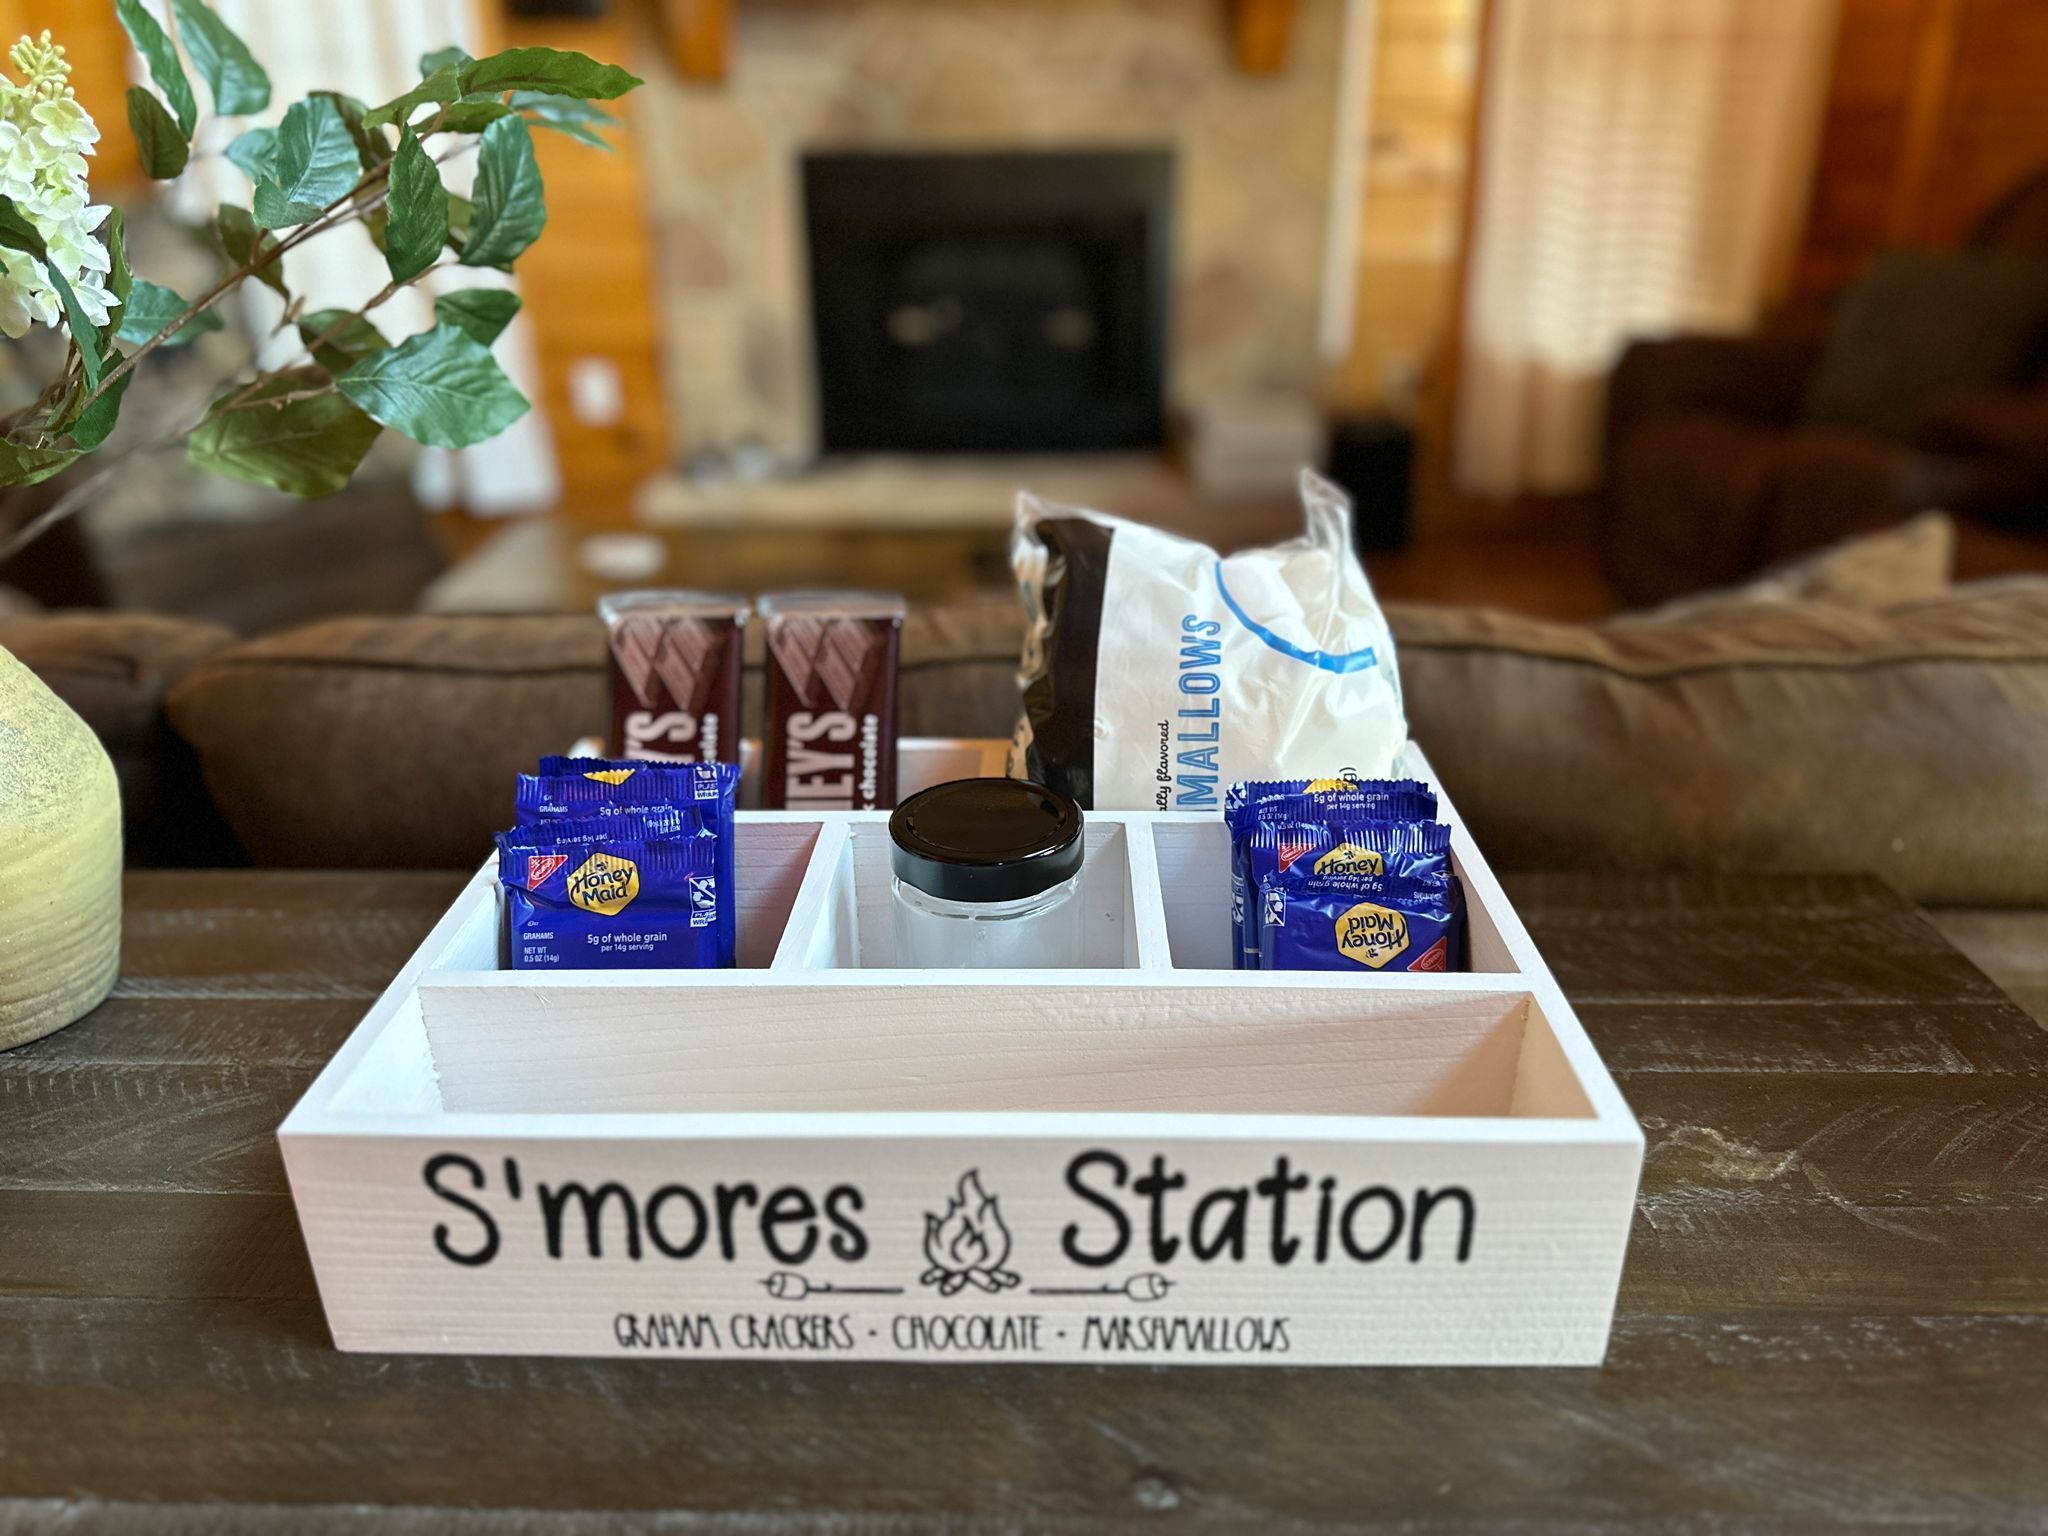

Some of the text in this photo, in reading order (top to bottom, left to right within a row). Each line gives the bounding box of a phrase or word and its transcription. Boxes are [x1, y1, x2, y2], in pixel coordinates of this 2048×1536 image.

[1176, 614, 1221, 811] MALLOWS
[860, 714, 878, 799] chocolate
[1156, 720, 1172, 781] flavored
[1313, 792, 1390, 804] 5g of whole grain
[1351, 802, 1376, 810] serving
[540, 804, 568, 813] GRAHAMS
[613, 805, 622, 815] of
[624, 804, 649, 815] whole
[1317, 858, 1379, 876] Honey
[570, 866, 634, 904] Honey
[1308, 880, 1384, 892] 5g of whole grain
[582, 882, 628, 907] Maid
[1347, 912, 1395, 934] Maid
[523, 932, 554, 940] GRAHAMS
[587, 931, 667, 945] 5g of whole grain
[1341, 918, 1406, 950] Honey
[524, 946, 547, 954] NET WT
[601, 943, 654, 953] per 14g serving
[524, 953, 560, 963] 0.5 OZ (14g)
[424, 1150, 1474, 1267] S'mores Station
[615, 1315, 1288, 1350] GRAHAM CRACKERS CHOCOLATE MARSHMALLOWS
